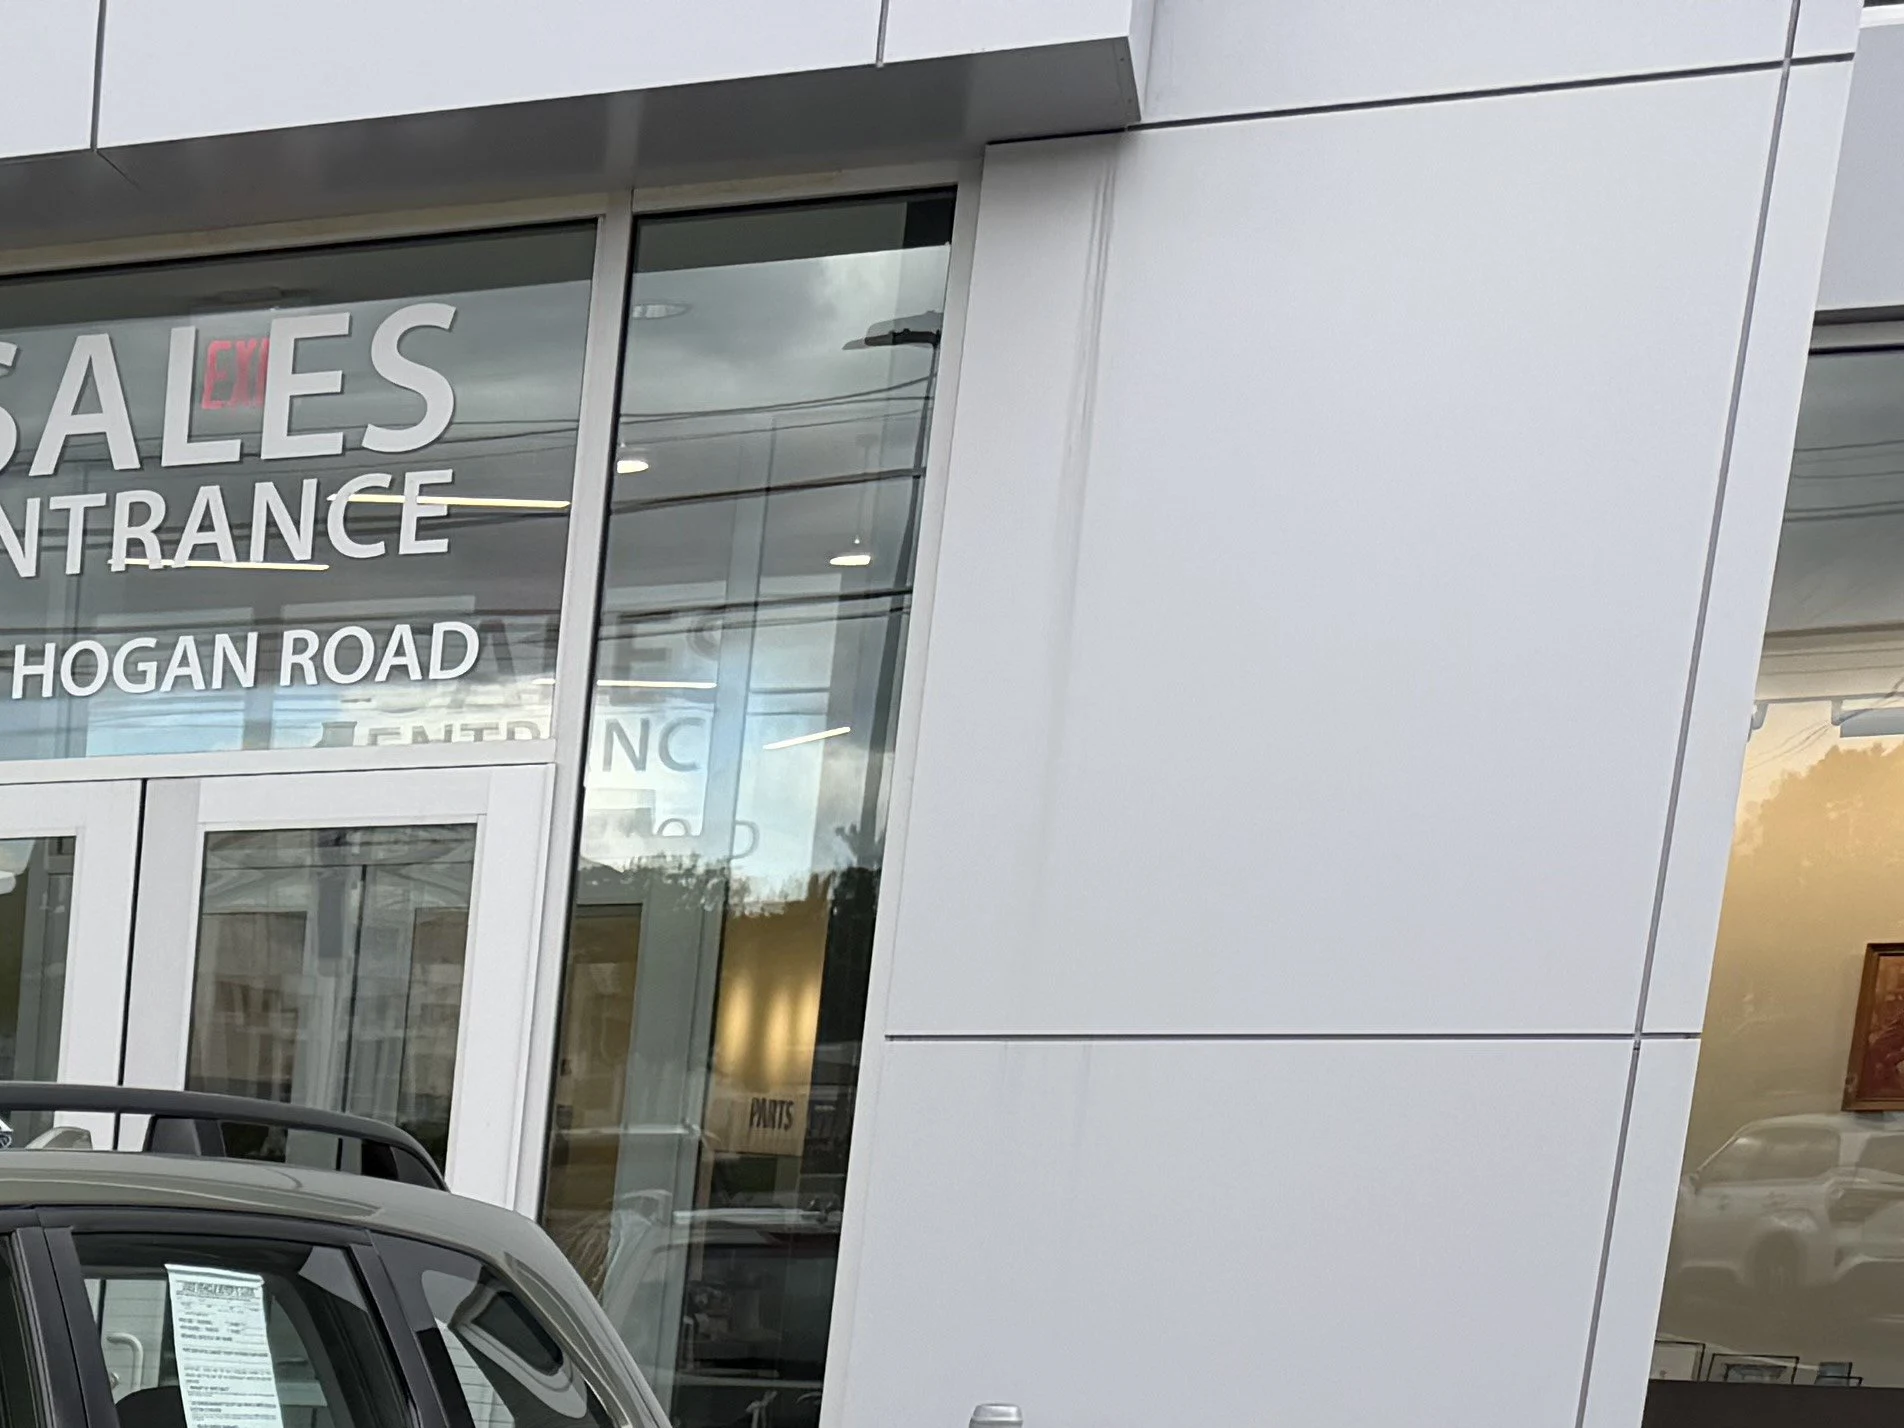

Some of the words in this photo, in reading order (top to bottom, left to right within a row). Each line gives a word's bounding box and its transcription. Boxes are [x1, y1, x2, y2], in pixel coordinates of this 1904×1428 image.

[201, 337, 271, 411] EXI
[10, 630, 257, 703] HOGAN
[279, 620, 480, 690] ROAD
[749, 1097, 795, 1132] PARTS
